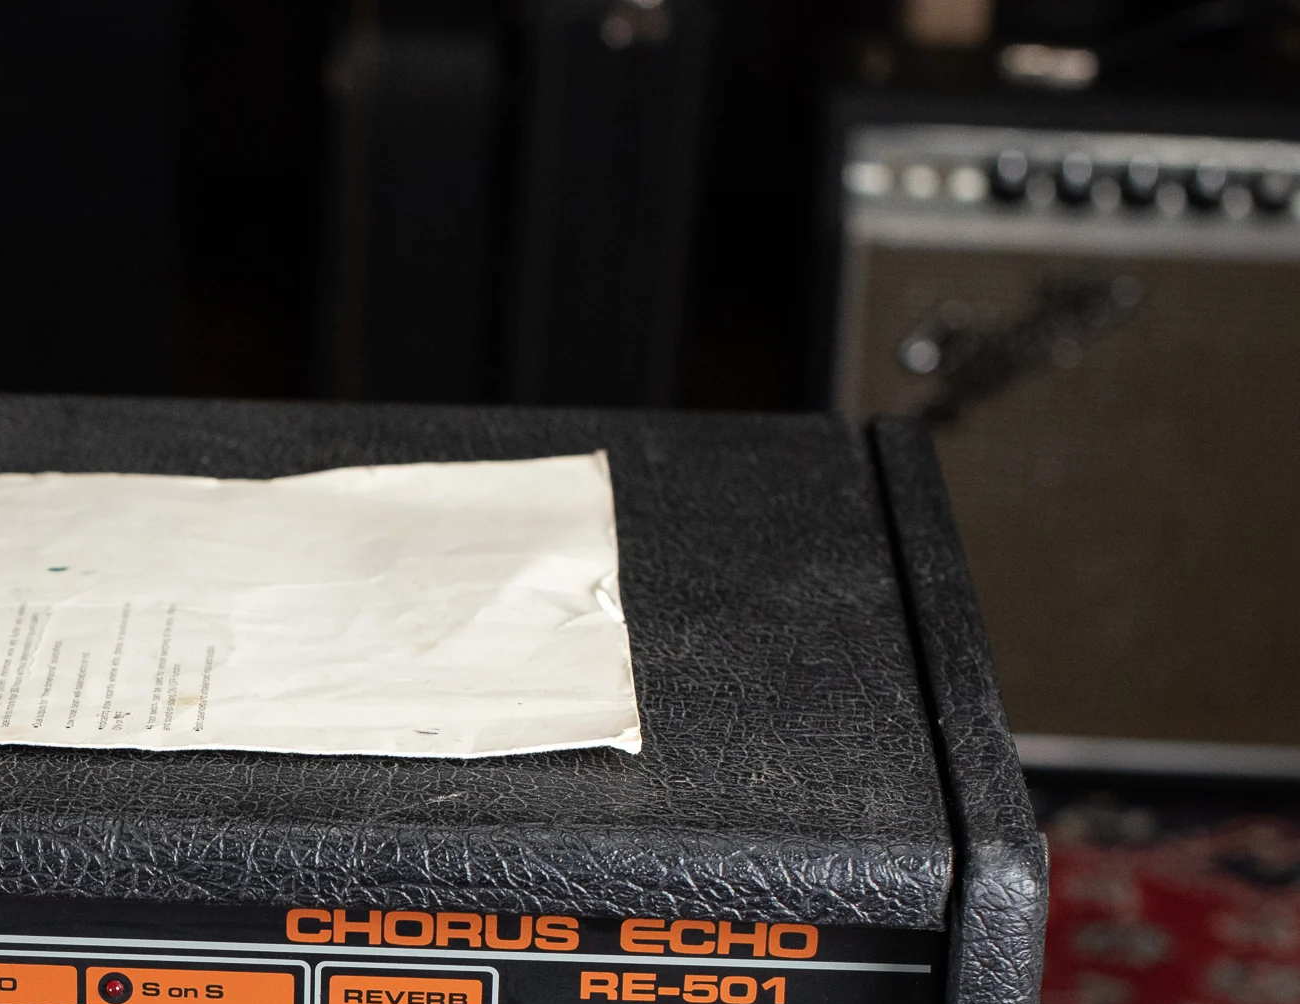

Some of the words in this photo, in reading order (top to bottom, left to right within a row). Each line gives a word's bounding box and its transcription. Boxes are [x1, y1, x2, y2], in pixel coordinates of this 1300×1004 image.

[286, 908, 580, 951] CHORUS
[620, 917, 819, 960] ECHO
[142, 982, 160, 998] S
[168, 987, 198, 999] on
[205, 984, 224, 999] S
[580, 971, 787, 1004] RE-501
